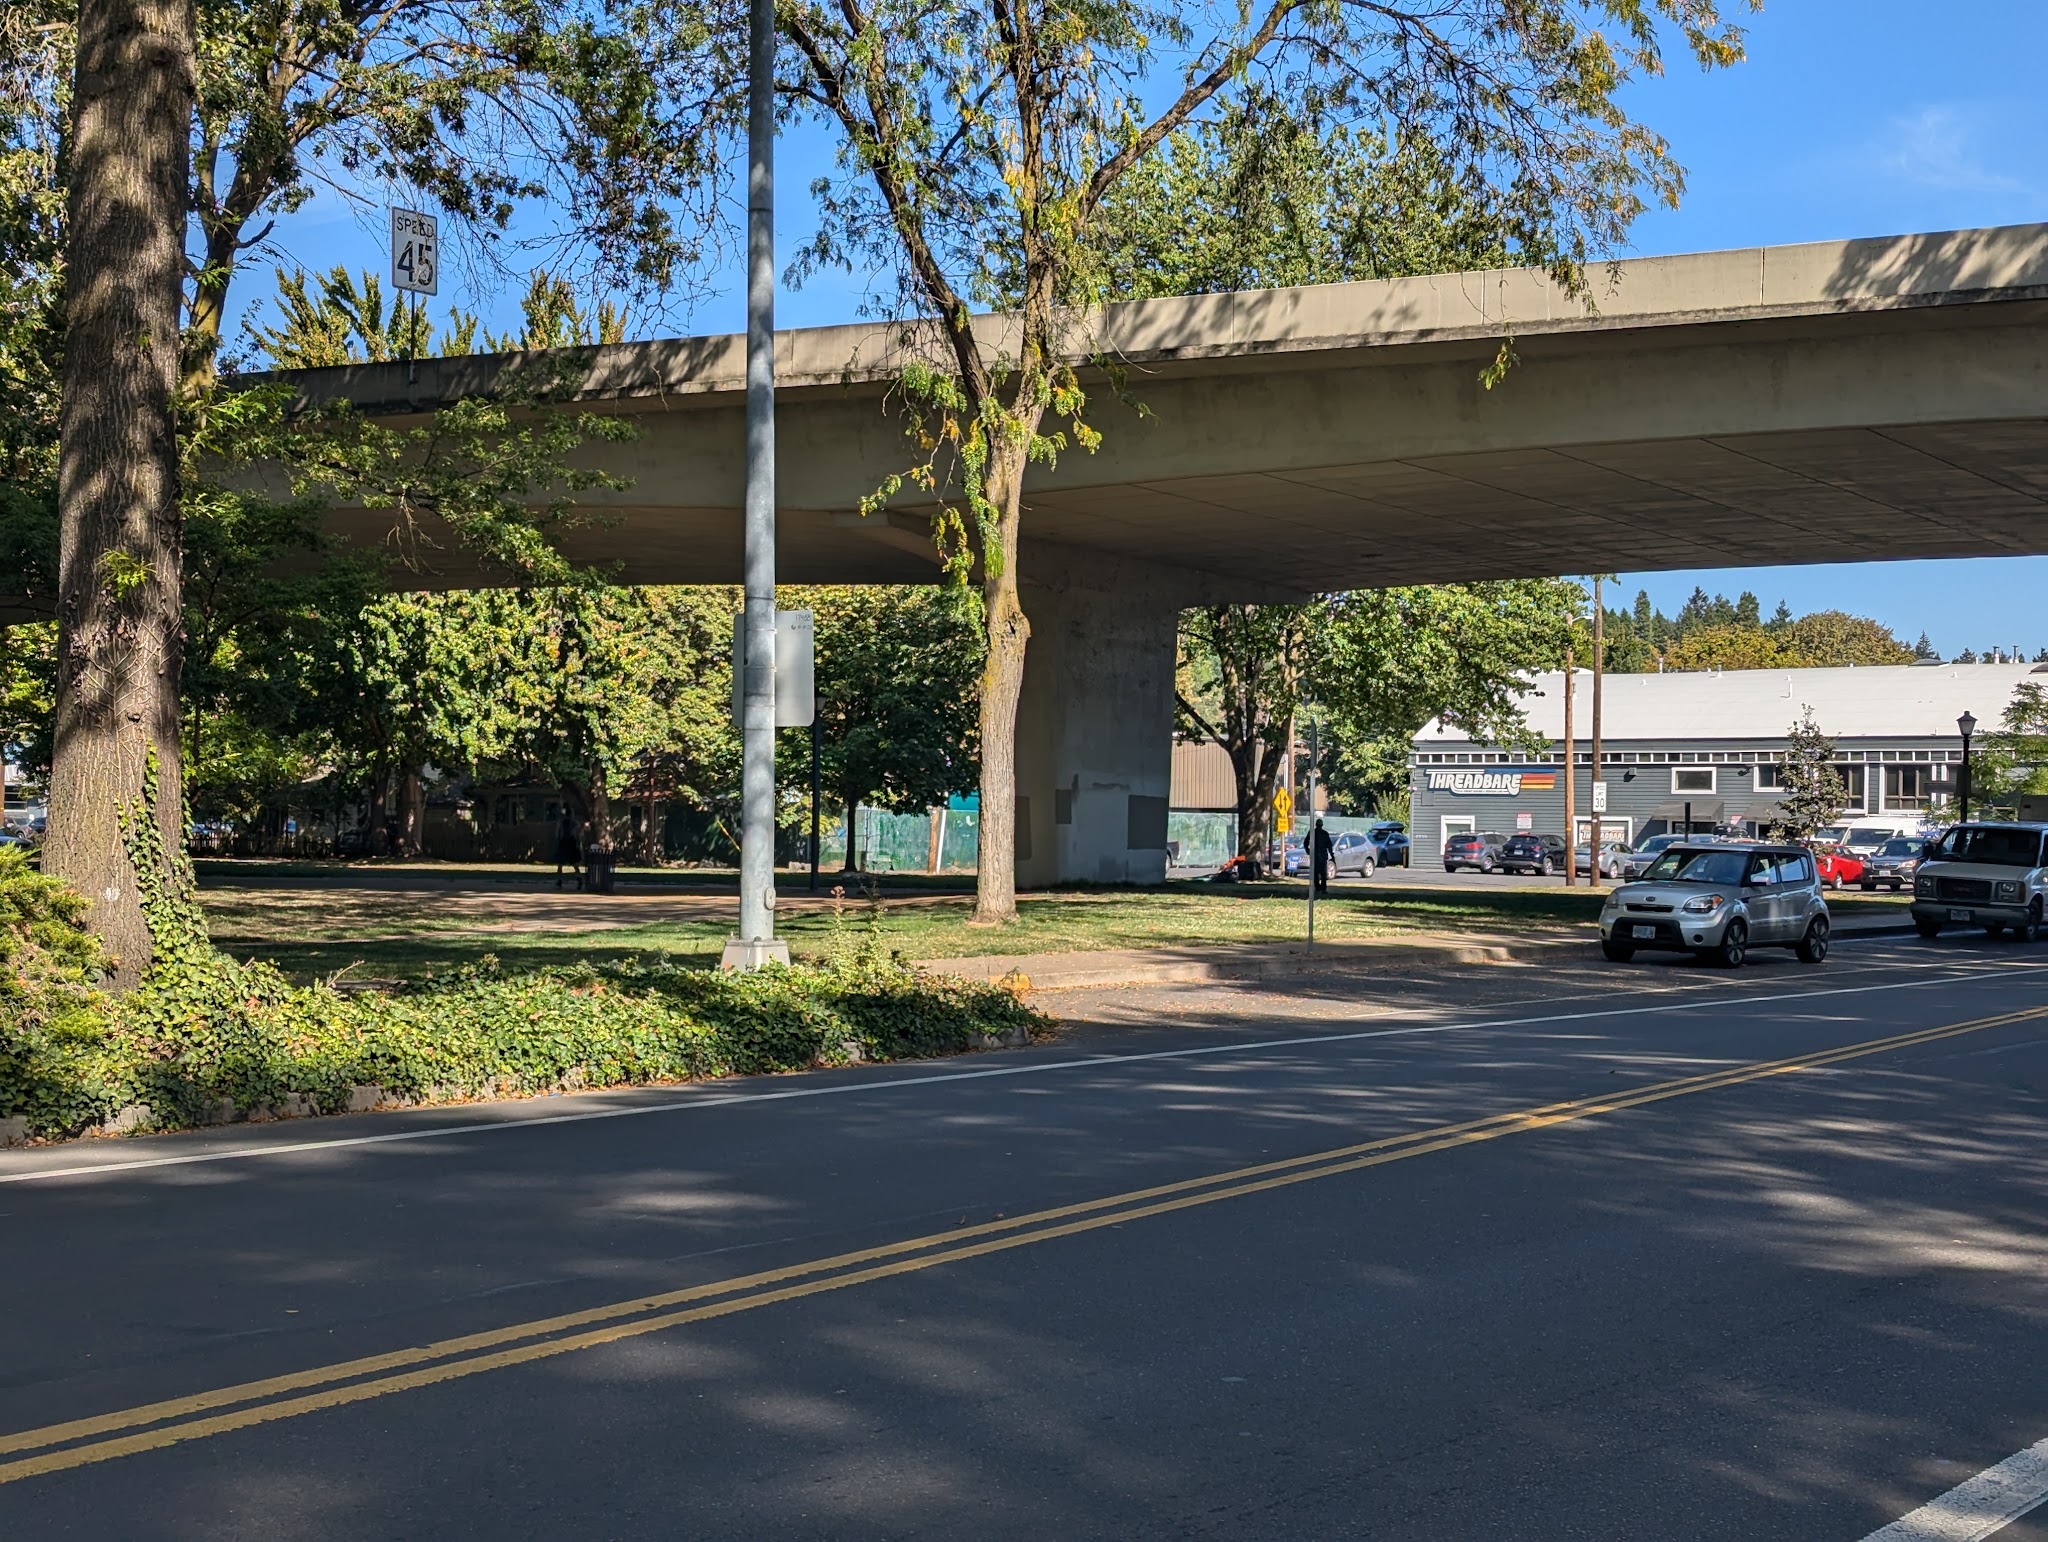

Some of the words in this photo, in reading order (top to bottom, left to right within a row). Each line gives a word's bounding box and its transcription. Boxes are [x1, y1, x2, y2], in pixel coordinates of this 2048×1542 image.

[396, 216, 434, 238] SPEED
[397, 240, 434, 286] 45
[1425, 768, 1523, 796] THREADBARE
[1594, 797, 1605, 808] 30
